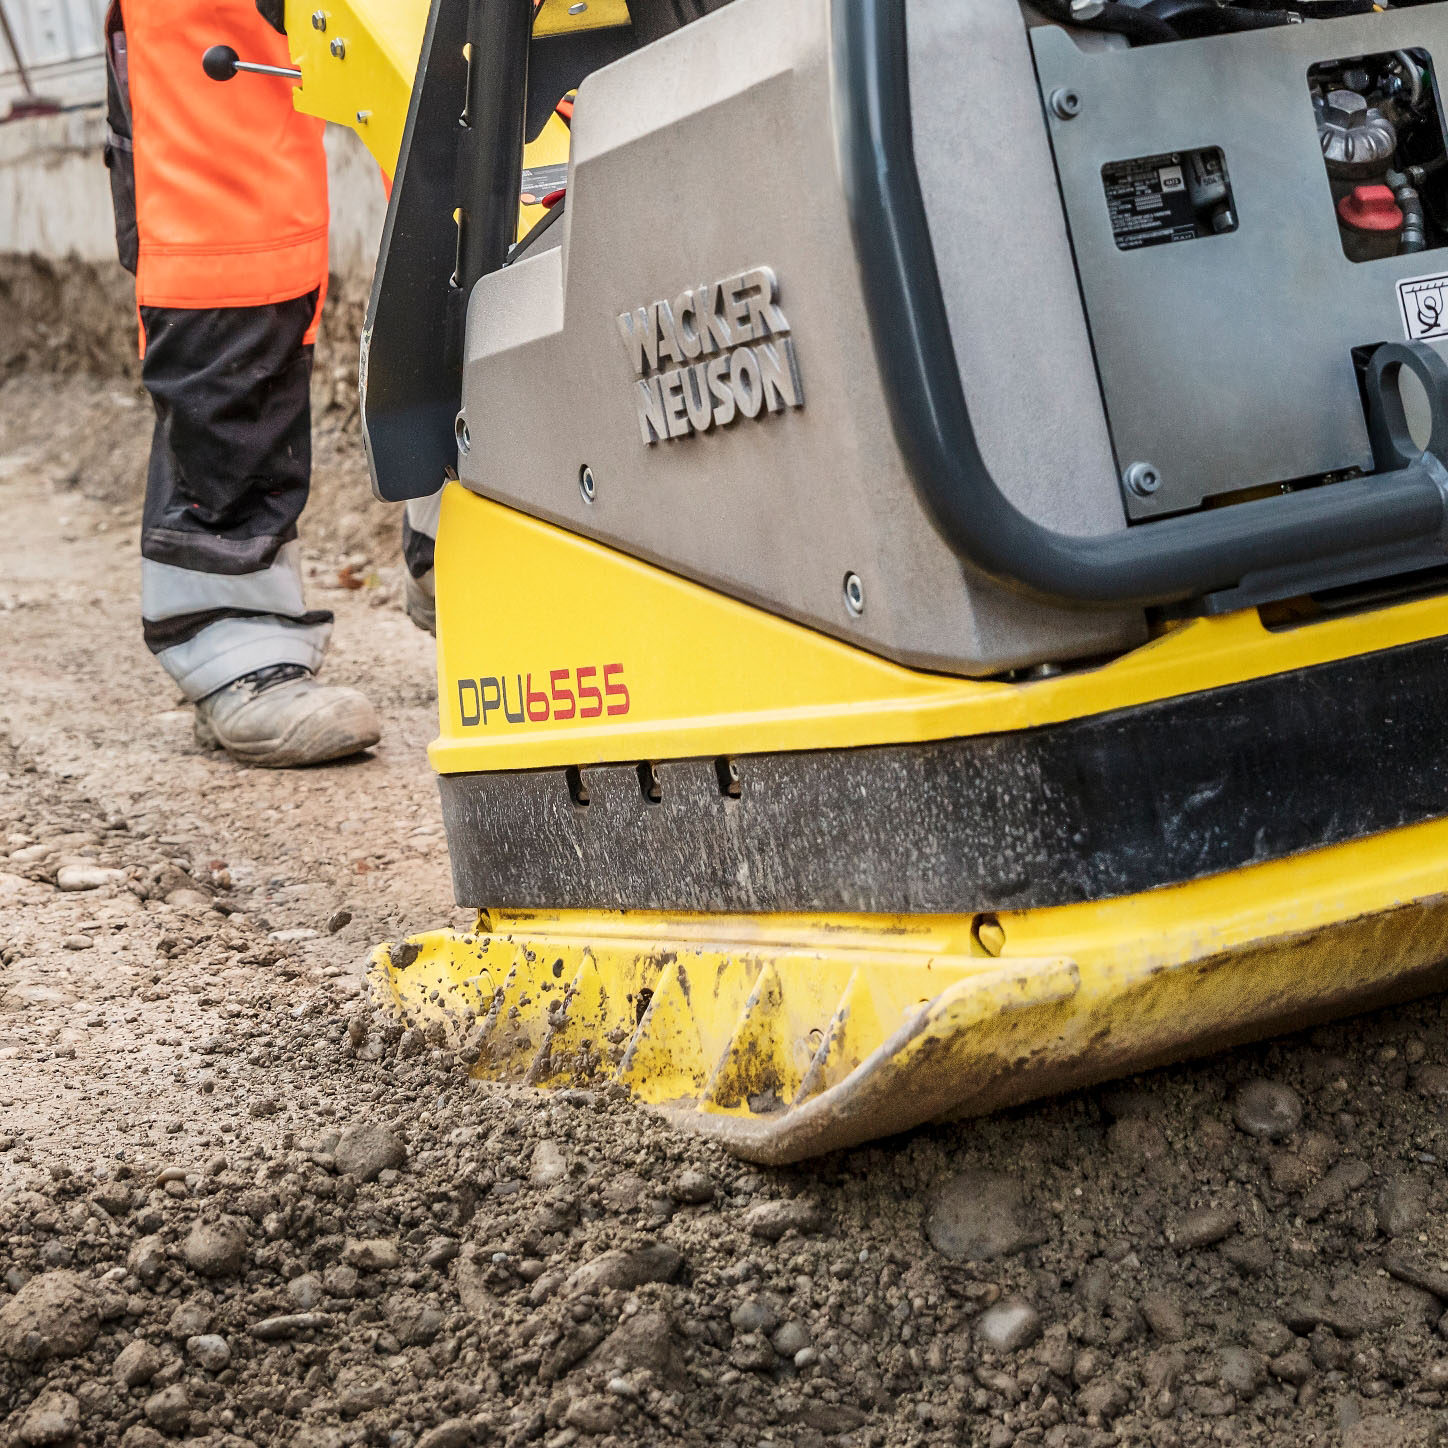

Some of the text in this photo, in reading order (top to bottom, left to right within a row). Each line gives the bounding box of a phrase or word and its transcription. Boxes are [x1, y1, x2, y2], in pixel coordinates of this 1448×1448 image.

[616, 265, 792, 374] WACKER
[637, 337, 803, 445] NEUSON
[458, 663, 630, 727] DPU6555
